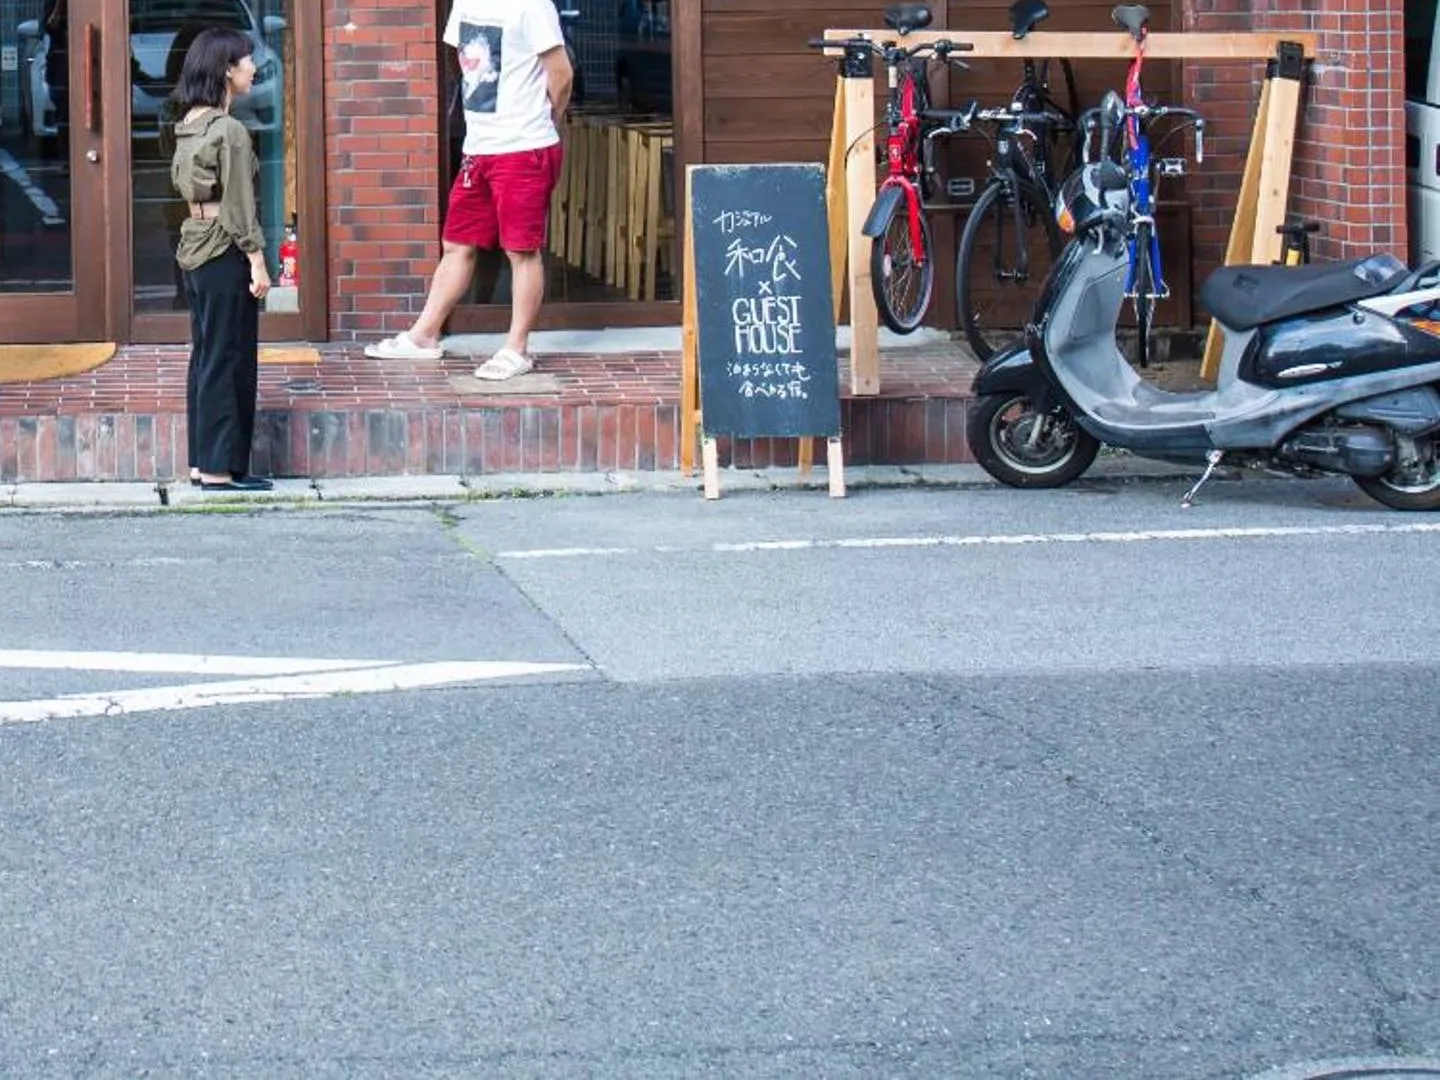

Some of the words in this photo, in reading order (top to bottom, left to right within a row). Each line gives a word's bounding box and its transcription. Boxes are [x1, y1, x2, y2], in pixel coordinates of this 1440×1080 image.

[724, 234, 802, 281] 和食
[732, 296, 803, 326] GUEST
[734, 323, 803, 354] HOUSE
